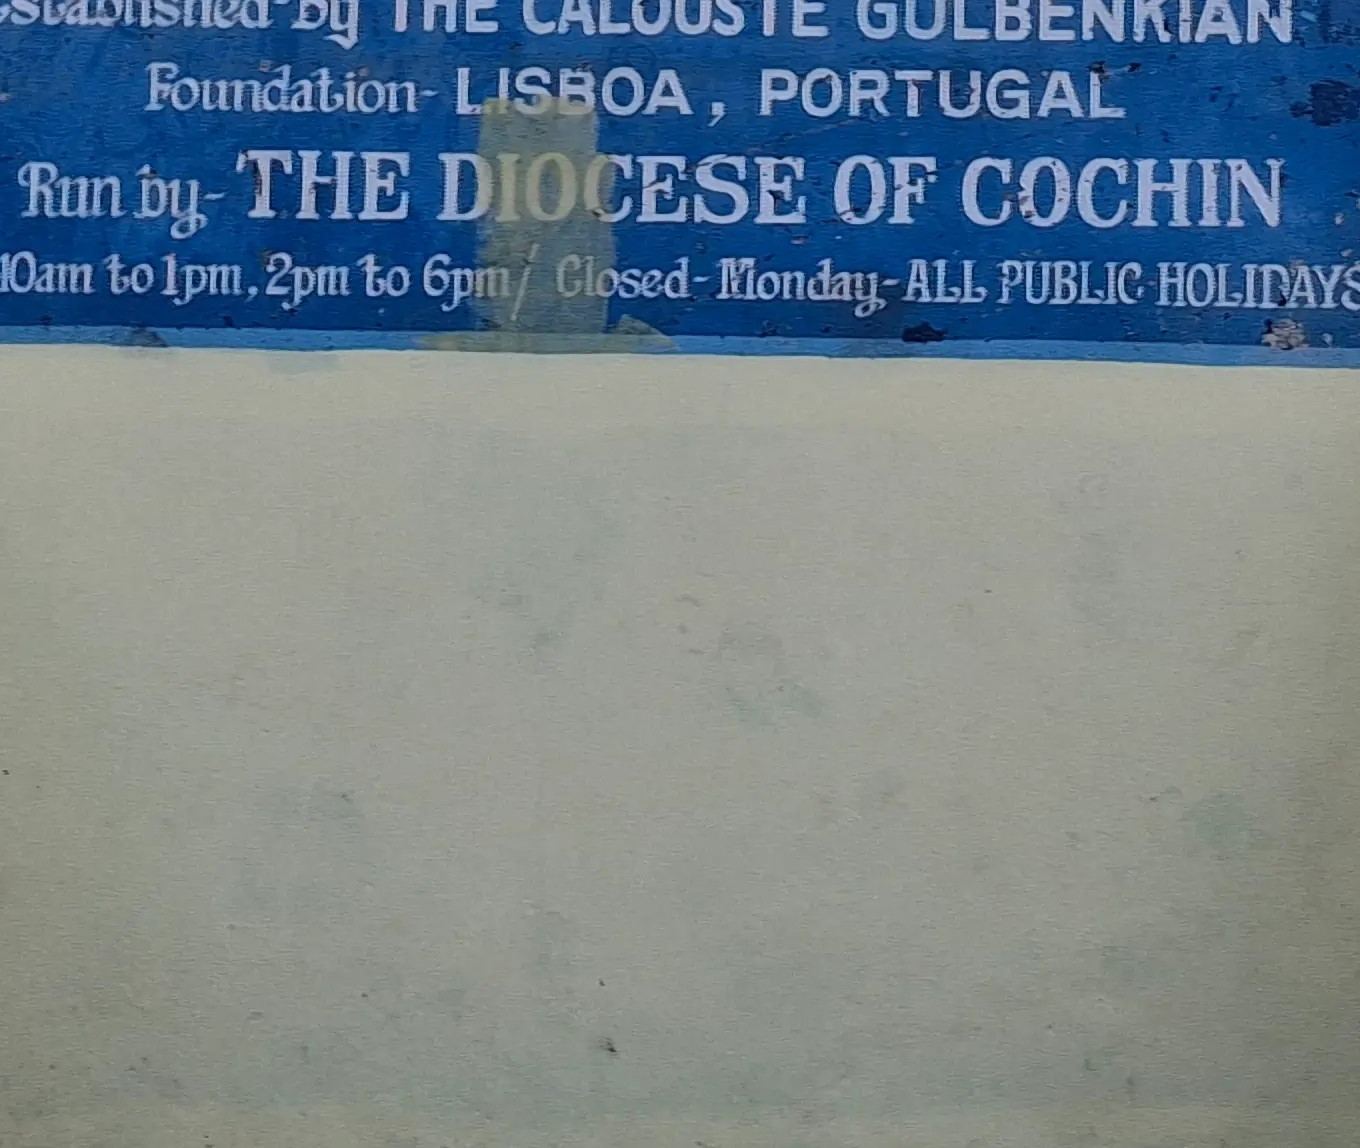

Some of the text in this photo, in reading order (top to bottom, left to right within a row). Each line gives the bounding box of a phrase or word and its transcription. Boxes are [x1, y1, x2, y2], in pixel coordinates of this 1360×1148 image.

[759, 69, 1127, 120] PORTUGAL
[17, 161, 123, 220] Run
[237, 149, 410, 221] THE
[436, 152, 808, 225] DIOCESE
[833, 155, 938, 225] OF
[961, 157, 1288, 230] COCHIN
[106, 254, 154, 295] to
[265, 252, 351, 312] 2pm
[357, 255, 411, 298] to
[998, 260, 1145, 306] PUBLIC
